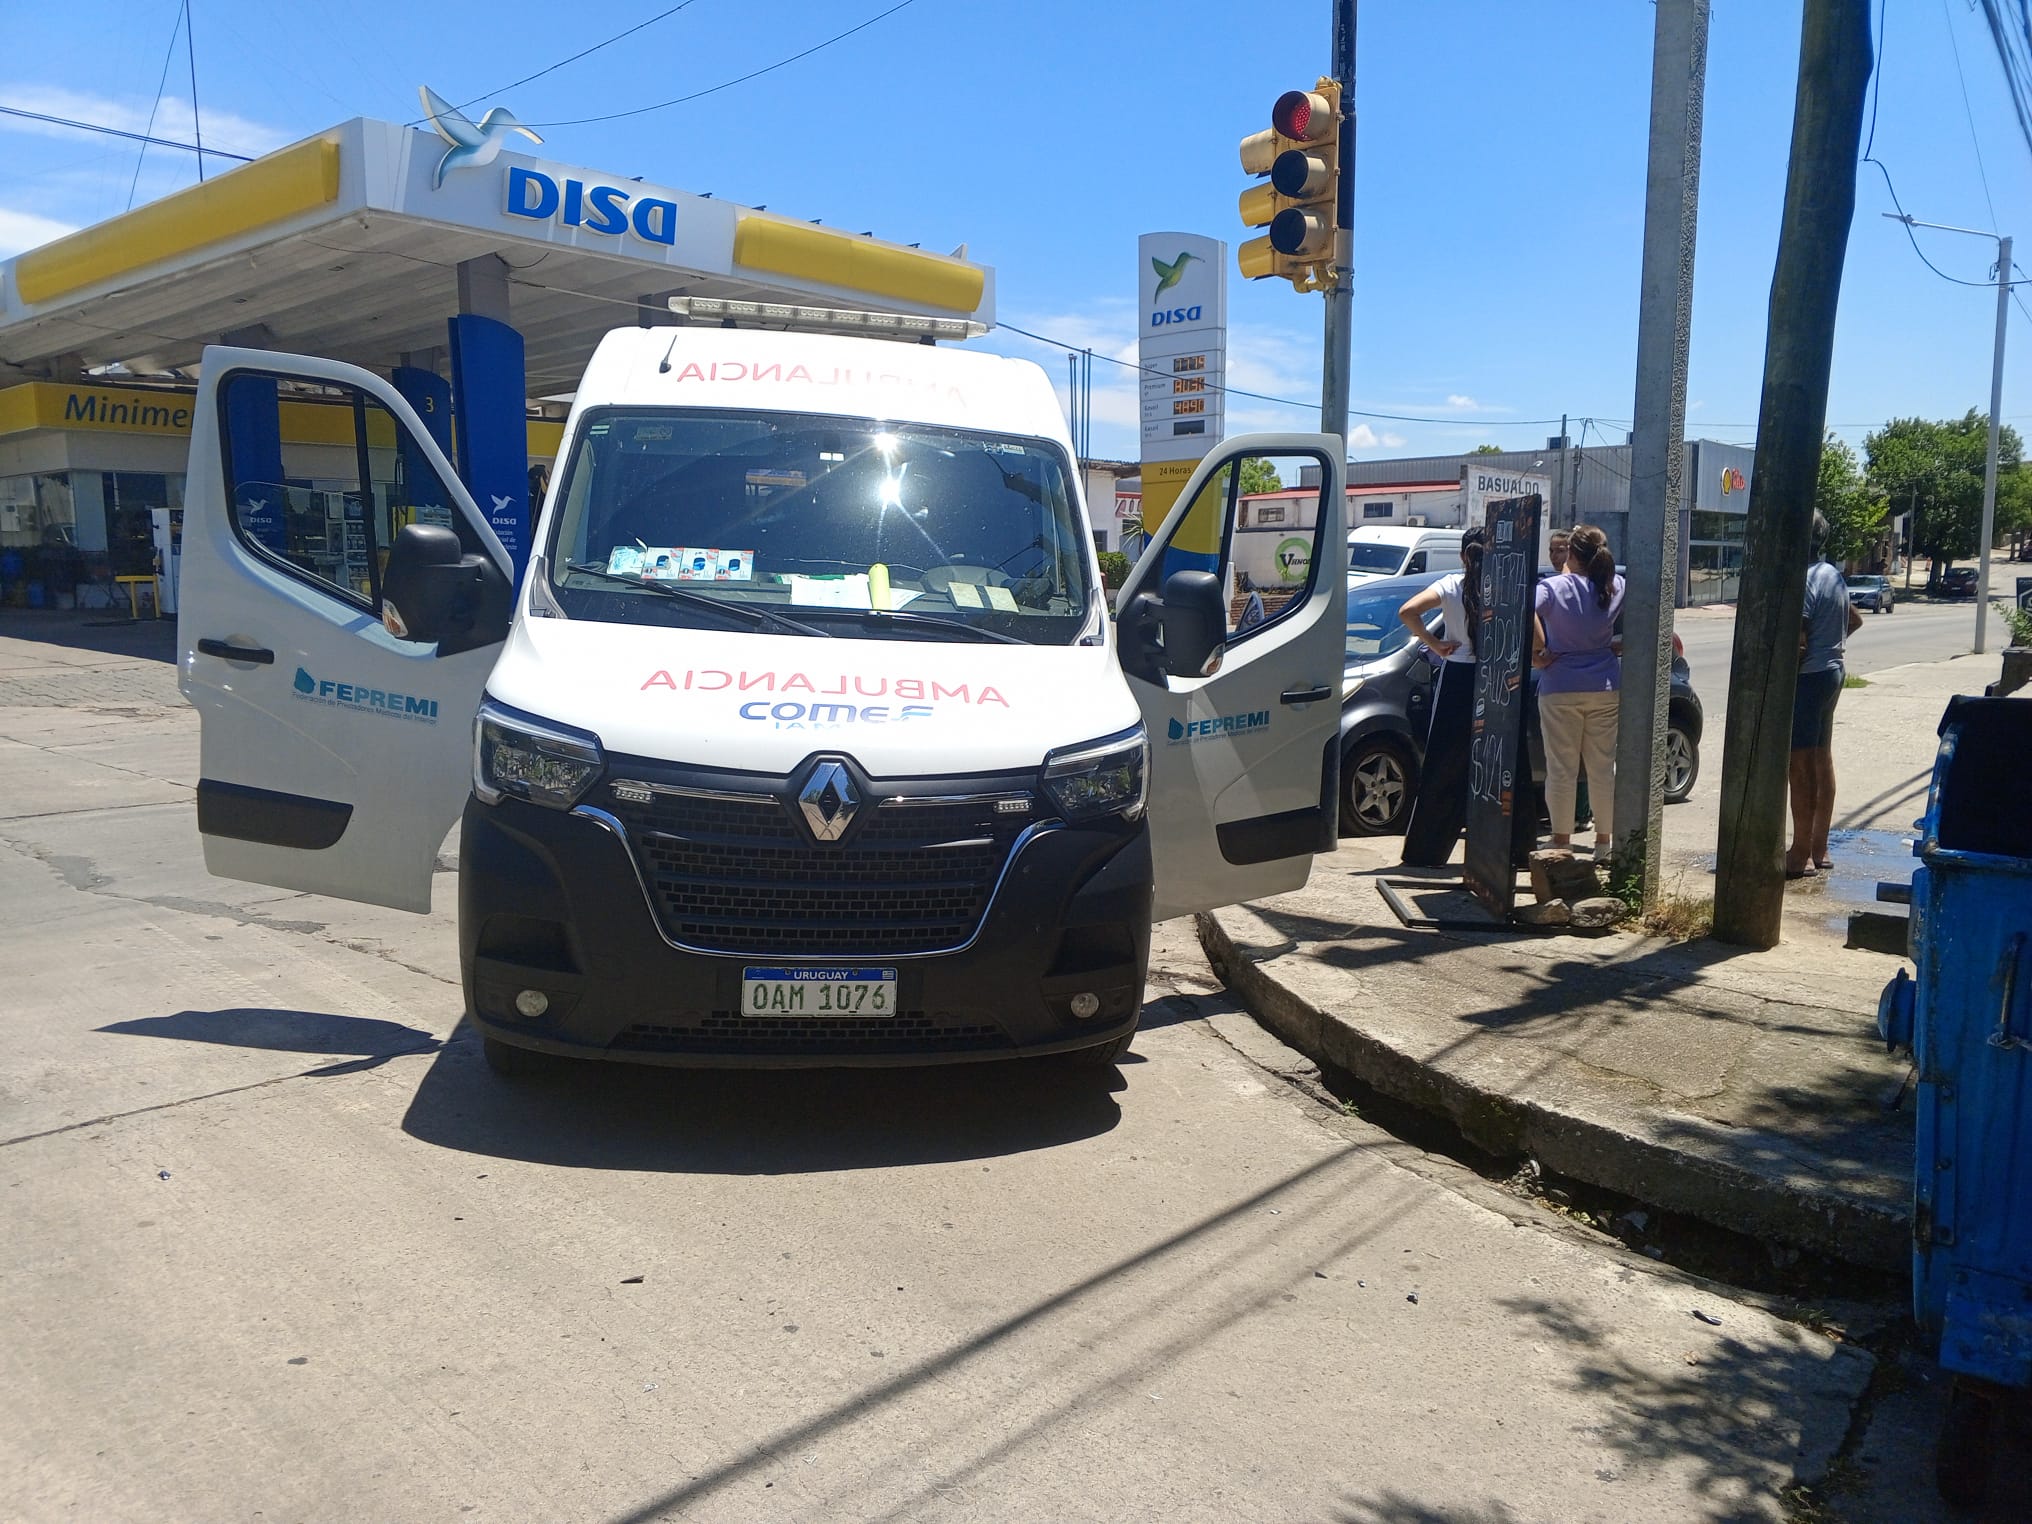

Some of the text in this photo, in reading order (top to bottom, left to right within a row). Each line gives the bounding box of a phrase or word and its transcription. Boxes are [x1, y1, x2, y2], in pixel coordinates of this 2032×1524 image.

[64, 393, 196, 428] Minime
[425, 396, 434, 413] 3
[1159, 466, 1192, 476] 24 Horas
[1478, 475, 1540, 497] BASUALDO
[319, 680, 438, 717] FEPREMI
[1187, 711, 1270, 737] FEPREMI
[793, 971, 849, 980] URUGUAY
[819, 984, 886, 1010] 1076
